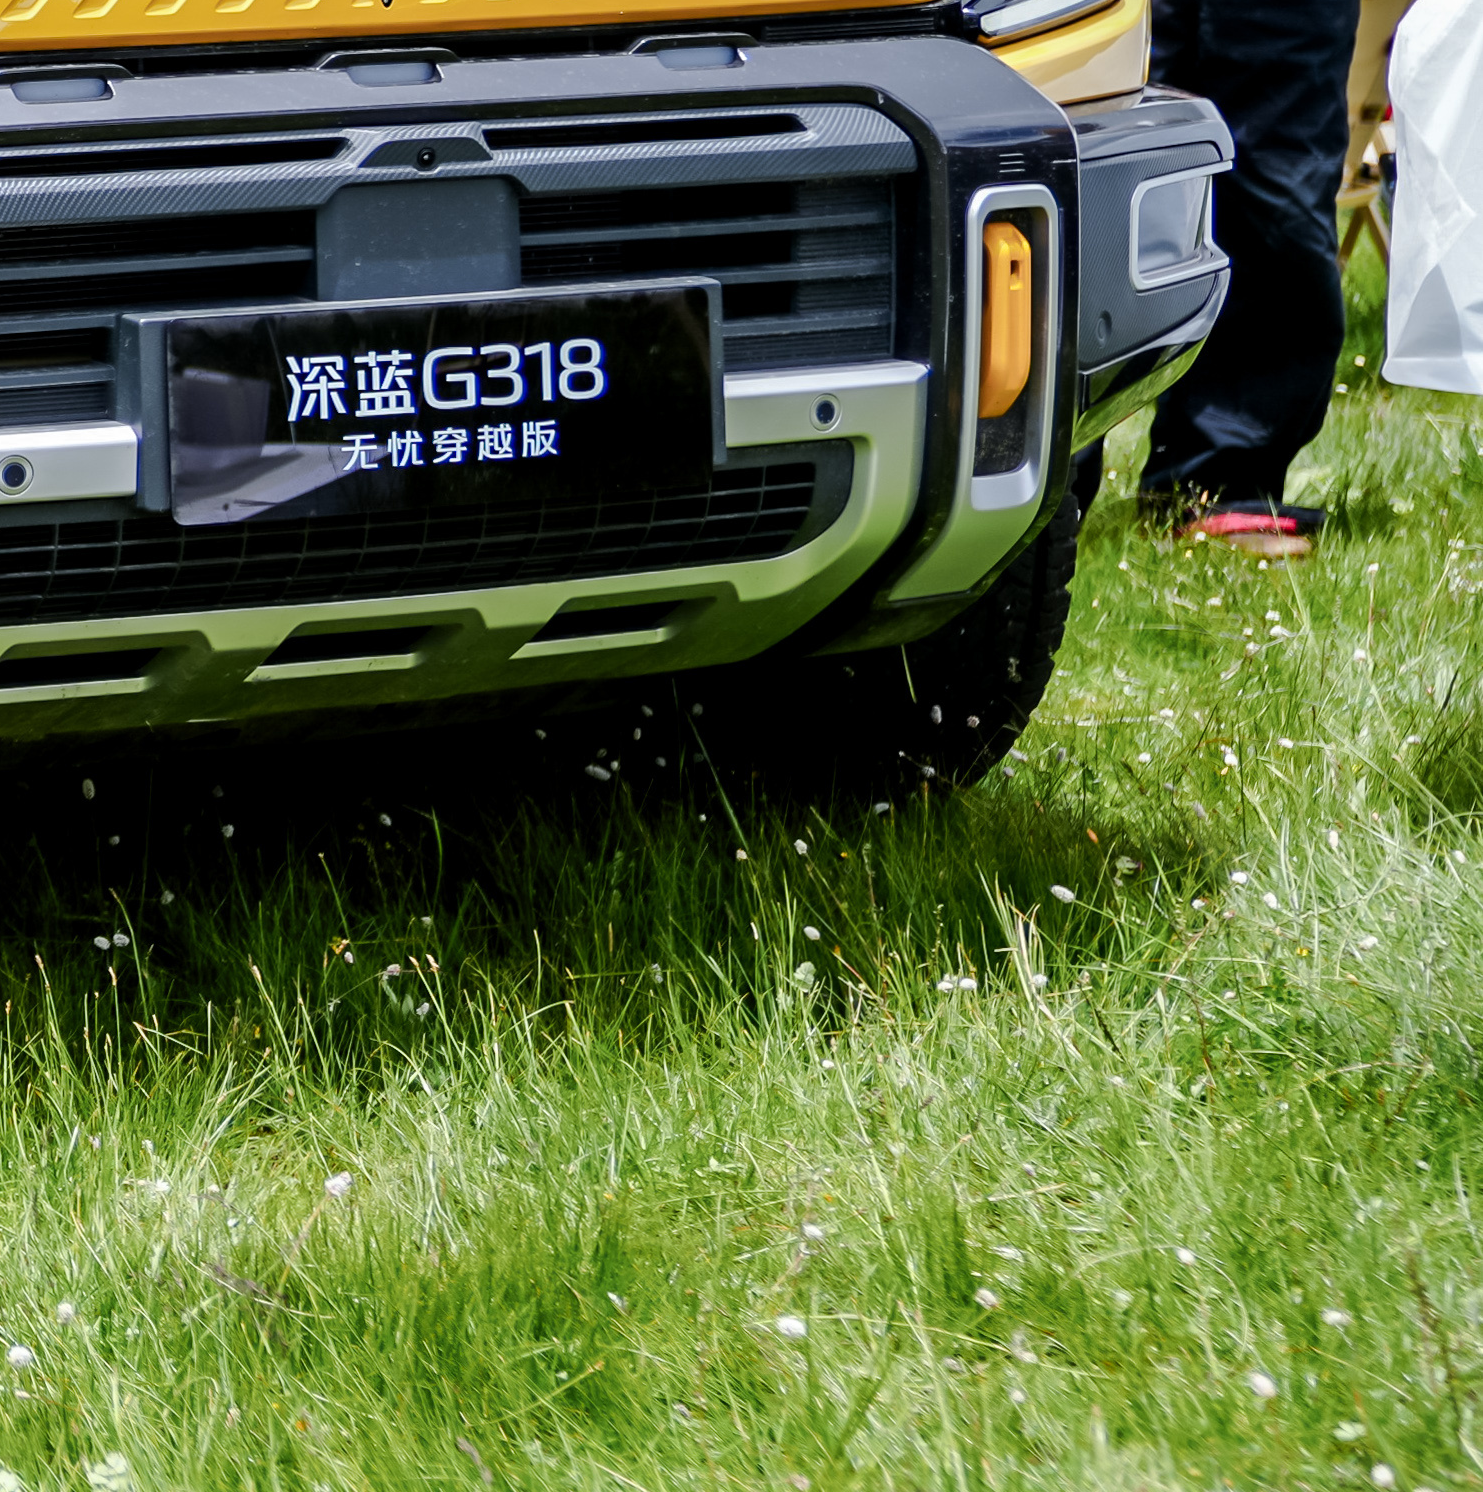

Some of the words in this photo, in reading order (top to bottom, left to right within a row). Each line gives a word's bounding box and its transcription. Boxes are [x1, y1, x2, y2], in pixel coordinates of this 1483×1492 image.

[285, 337, 608, 423] 深蓝G318
[340, 419, 559, 473] 无忧穿越版
